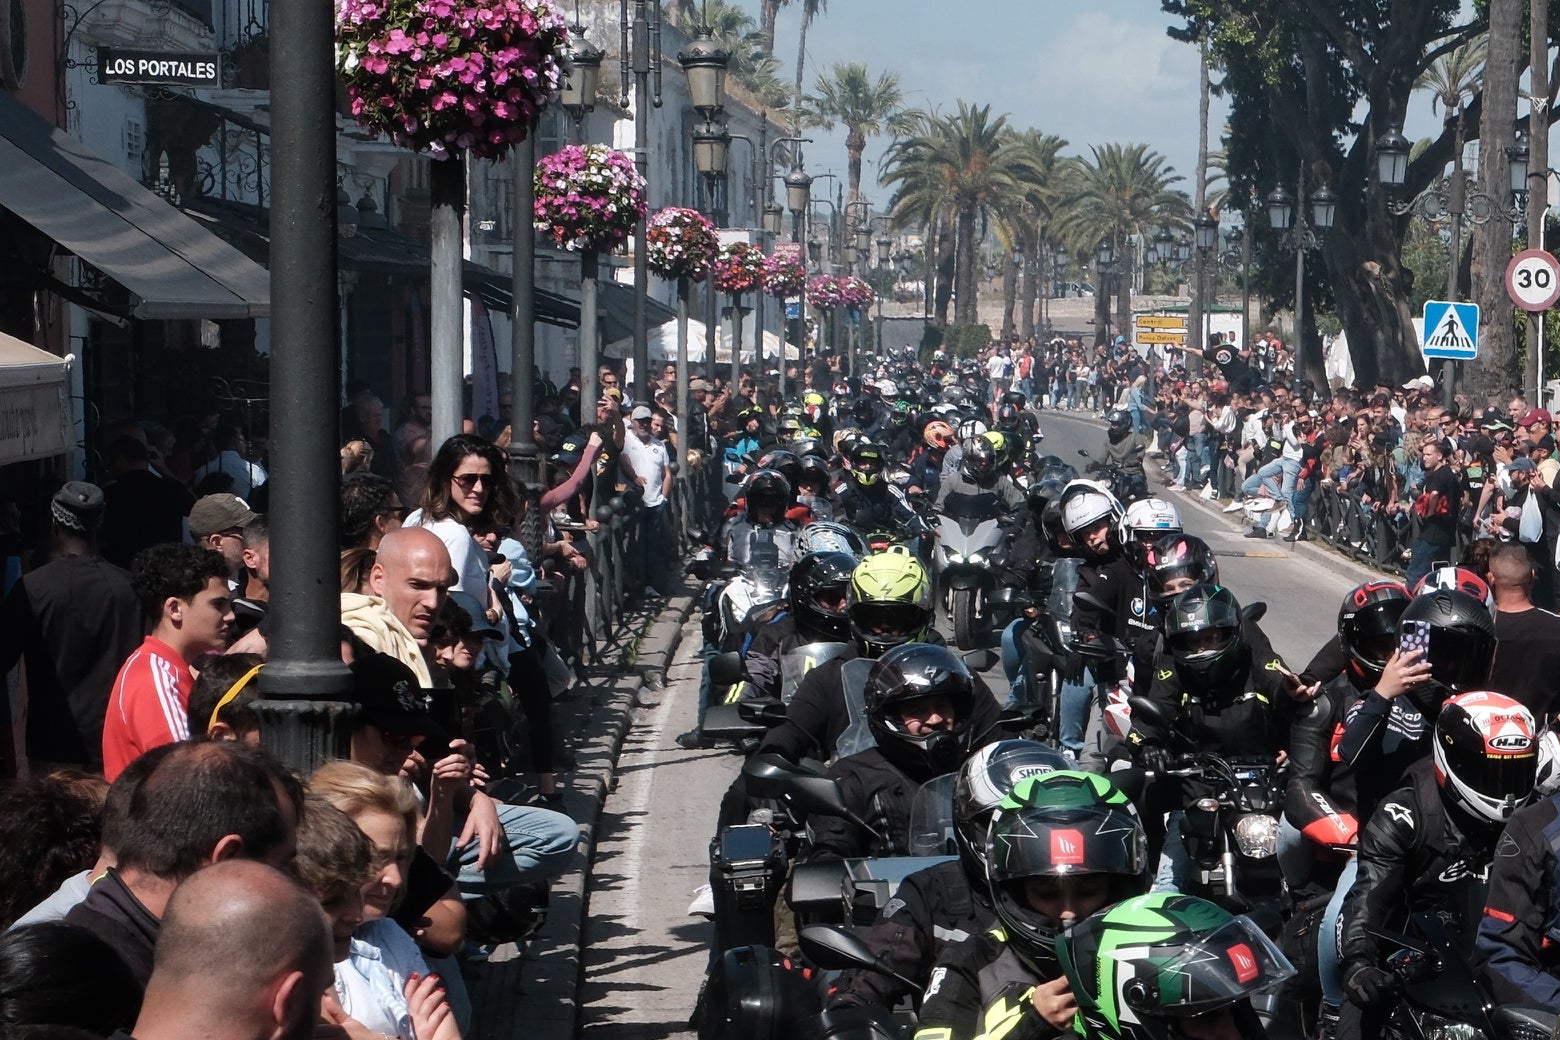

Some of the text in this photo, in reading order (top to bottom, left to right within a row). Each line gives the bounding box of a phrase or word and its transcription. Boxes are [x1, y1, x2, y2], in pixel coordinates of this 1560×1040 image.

[105, 59, 215, 79] LOS PORTALES
[1518, 268, 1550, 289] 30
[1495, 737, 1528, 747] HJC
